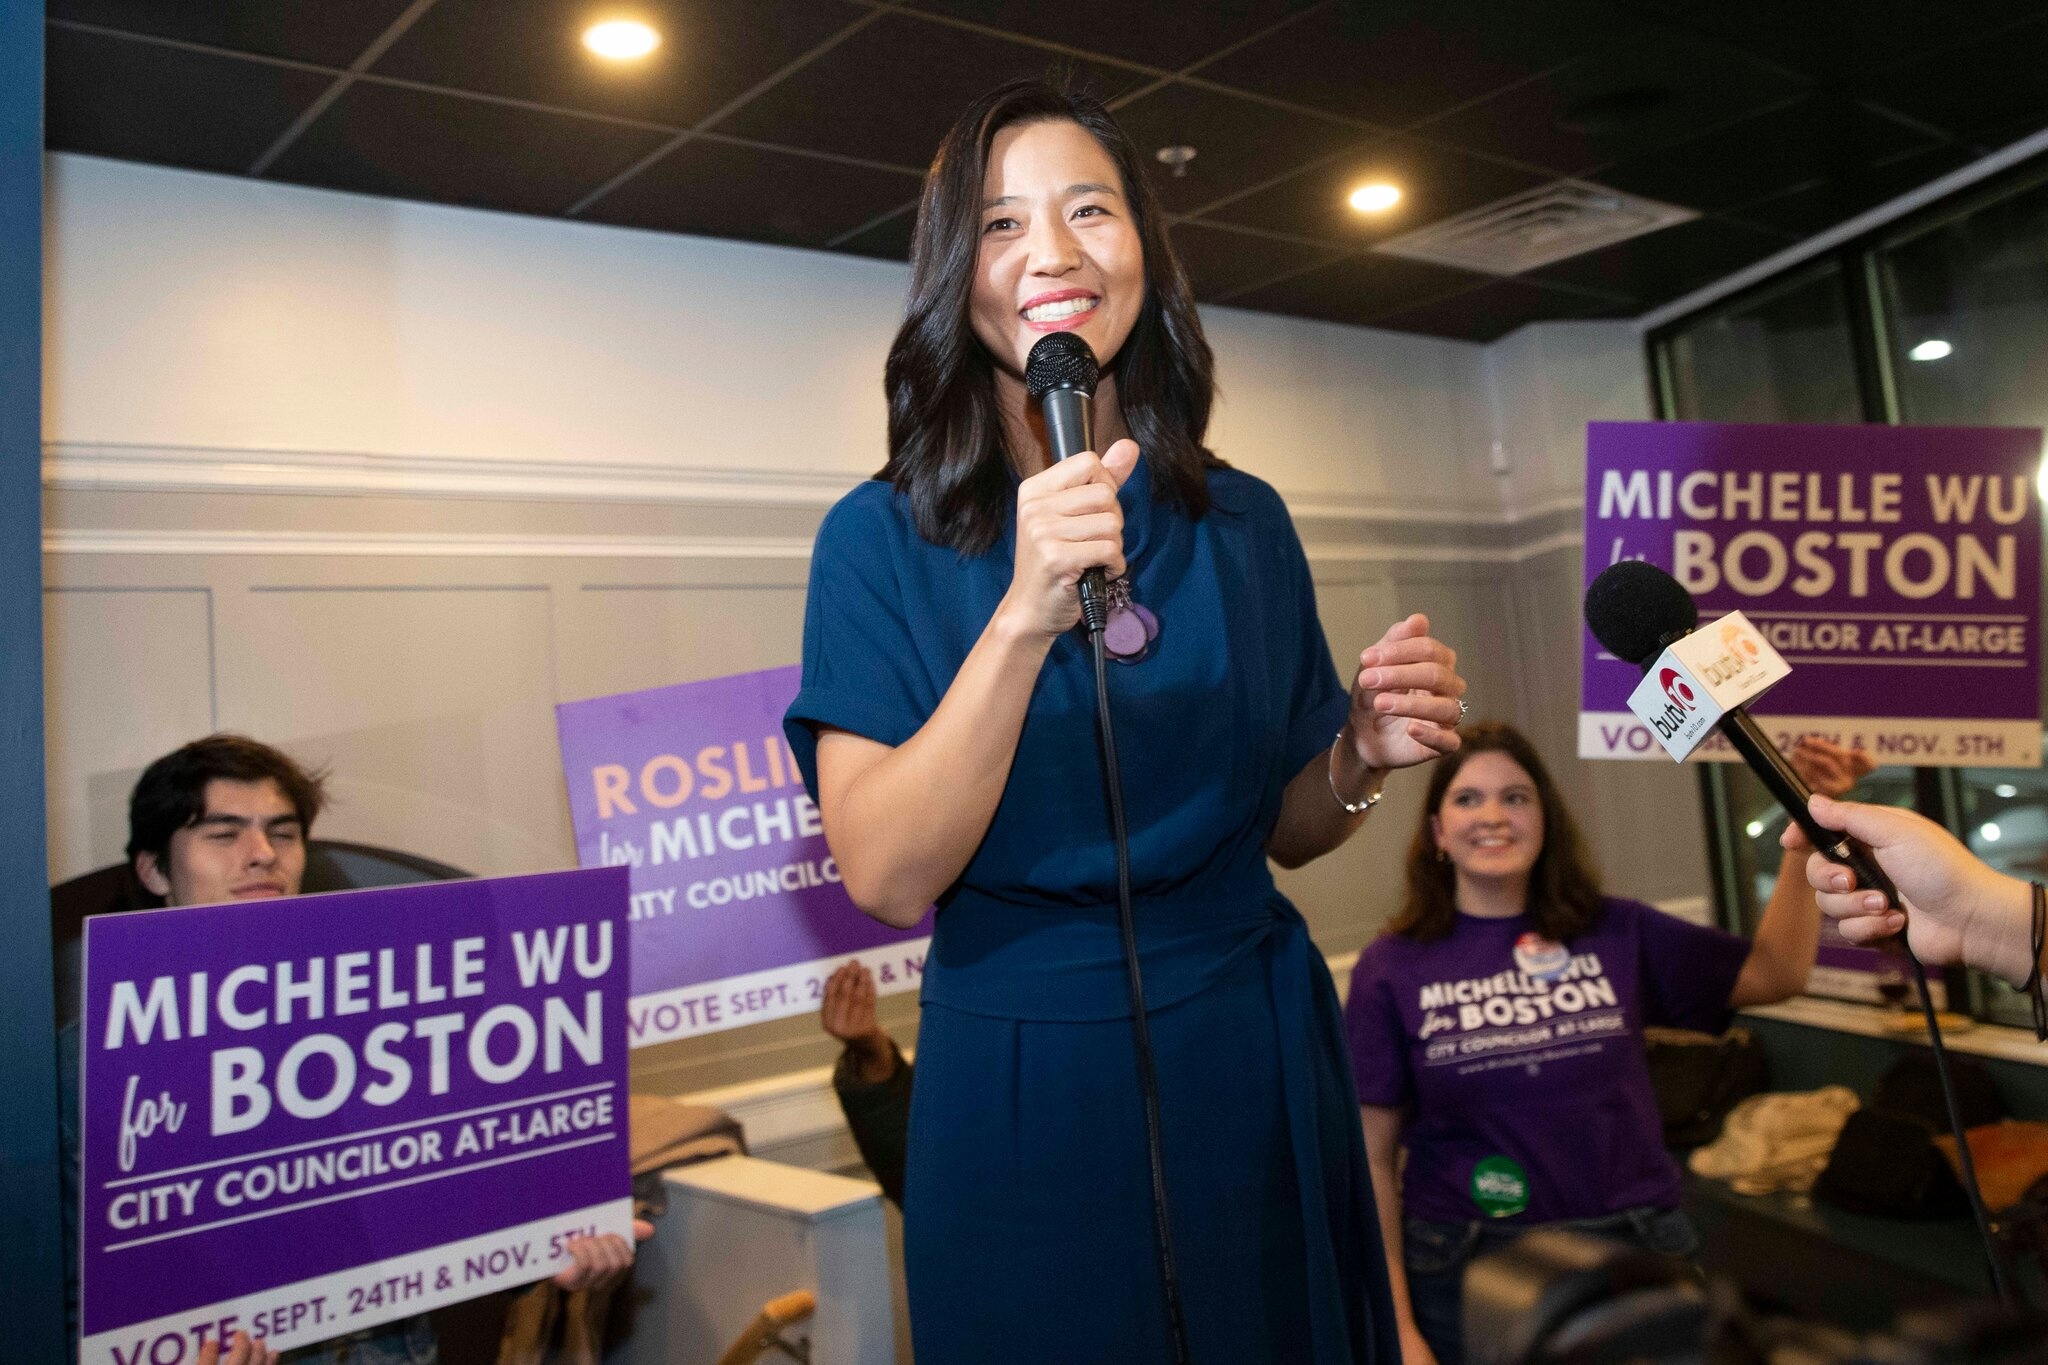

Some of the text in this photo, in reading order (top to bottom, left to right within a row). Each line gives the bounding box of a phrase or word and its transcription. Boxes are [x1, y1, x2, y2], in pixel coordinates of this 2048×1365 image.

[1600, 469, 2029, 525] MICHELLE WU
[1673, 529, 2017, 600] BOSTON
[1868, 623, 2026, 653] AT-LARGE
[1956, 734, 2005, 757] 5TH
[627, 886, 677, 921] ITY
[103, 919, 614, 1051] MICHELLE WU
[628, 994, 723, 1037] VOTE
[731, 982, 799, 1016] SEPT.
[880, 961, 897, 984] &
[1458, 976, 1618, 1032] BOSTON
[117, 989, 604, 1173] for BOSTON
[107, 1095, 614, 1231] CITY COUNCILOR AT-LARGE
[252, 1296, 337, 1340] SEPT.
[347, 1272, 424, 1316] 24TH
[433, 1265, 454, 1291] &
[464, 1241, 539, 1283] NOV.
